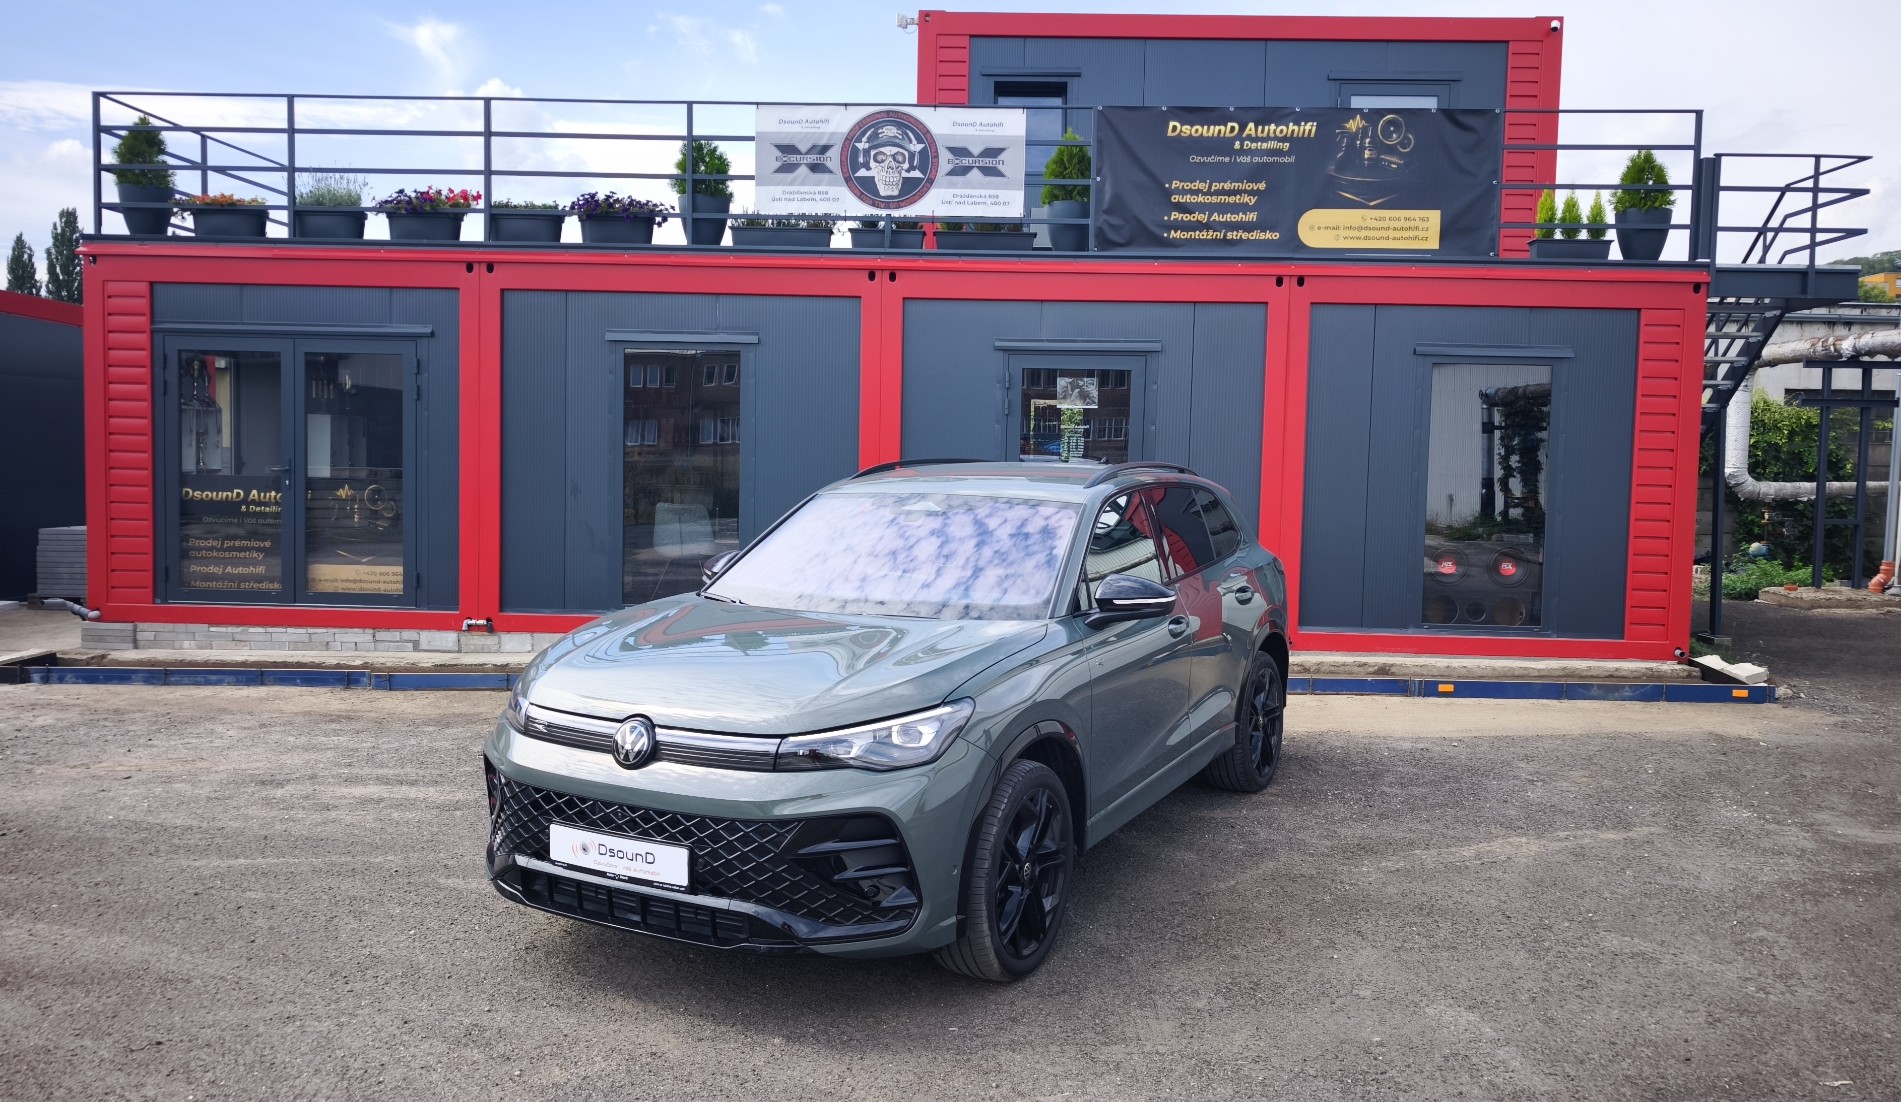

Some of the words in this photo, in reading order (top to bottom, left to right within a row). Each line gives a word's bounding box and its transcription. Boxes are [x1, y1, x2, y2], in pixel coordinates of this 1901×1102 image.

[1167, 121, 1240, 137] DsounD
[1242, 122, 1318, 138] Autohifi
[1234, 141, 1240, 150] &
[1244, 141, 1290, 151] Detailing
[1190, 154, 1230, 163] Ozvučíme
[1236, 154, 1250, 163] Váš
[1172, 180, 1210, 192] Prodej
[1211, 180, 1266, 192] prémiové
[1171, 194, 1258, 205] autokosmetiky
[1170, 212, 1208, 223] Prodej
[1210, 212, 1258, 222] Autohifi
[1170, 230, 1224, 239] Montážní
[1226, 230, 1280, 240] středisko
[182, 488, 244, 502] DsounD
[188, 538, 222, 548] Prodej
[224, 539, 272, 548] prémiové
[189, 550, 264, 560] autokosmetiky
[190, 565, 224, 574] Prodej
[190, 580, 238, 588] Montážní
[240, 581, 282, 590] středisk
[598, 843, 656, 864] DsounD
